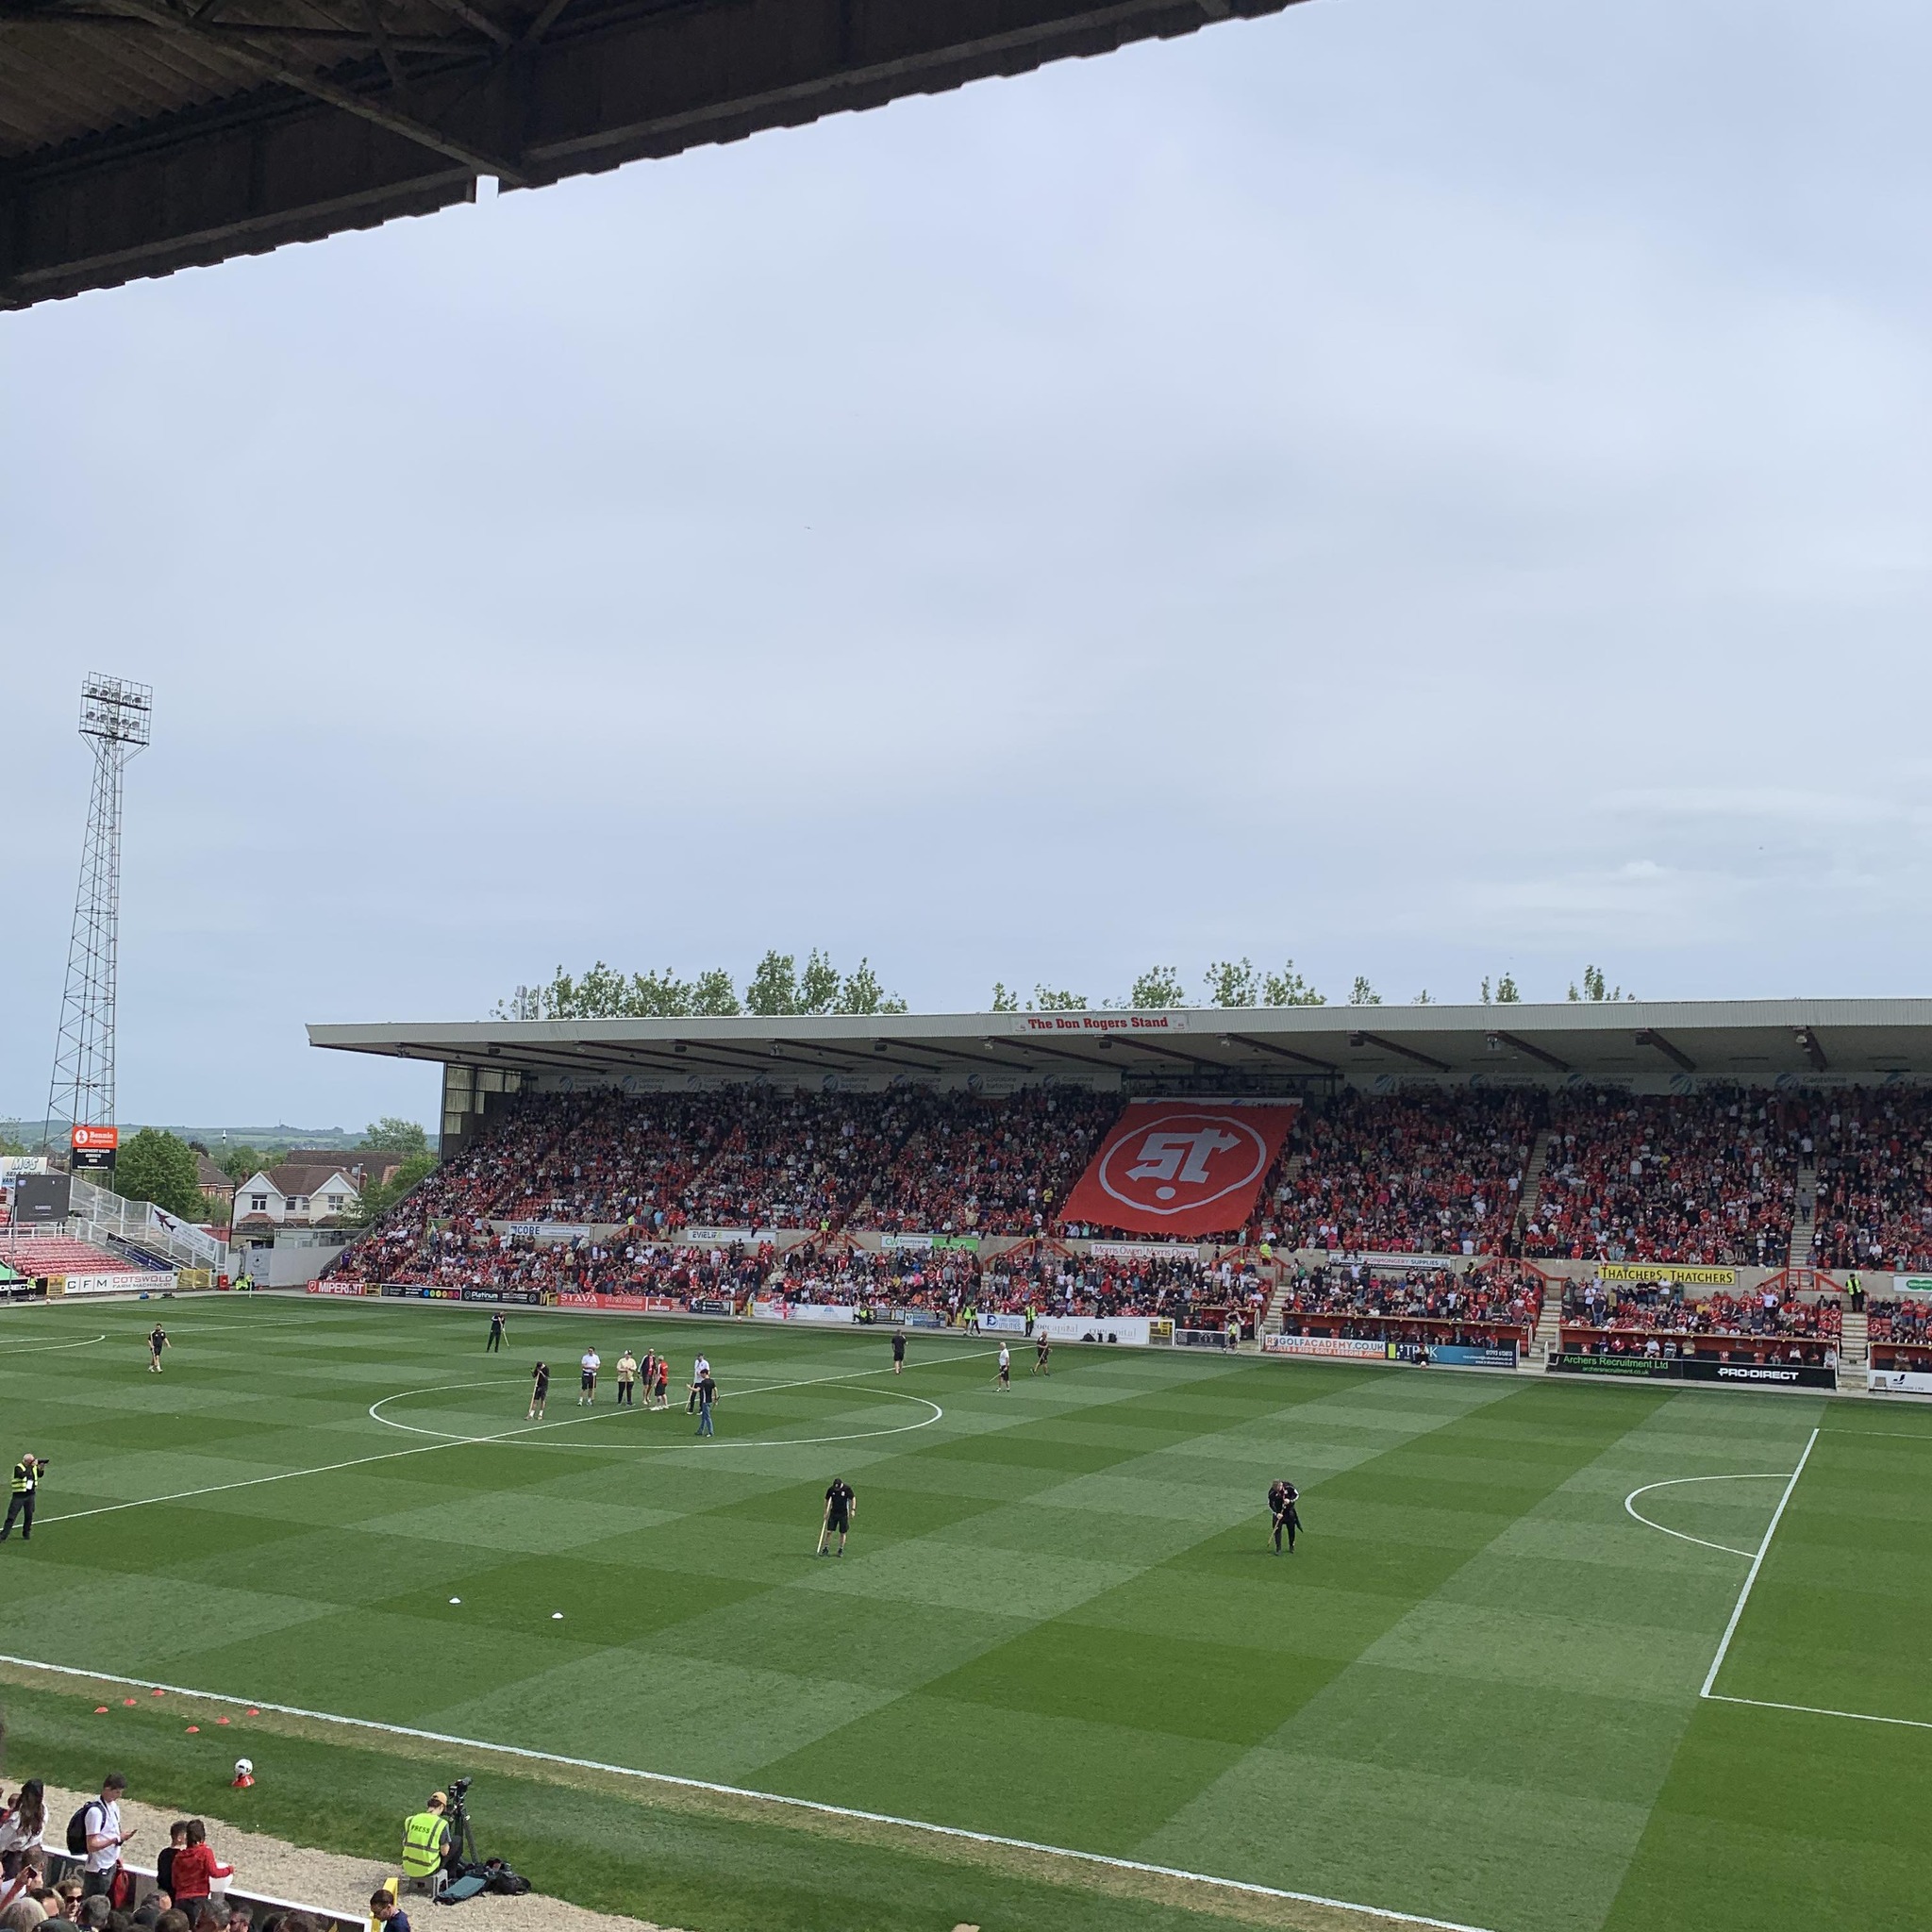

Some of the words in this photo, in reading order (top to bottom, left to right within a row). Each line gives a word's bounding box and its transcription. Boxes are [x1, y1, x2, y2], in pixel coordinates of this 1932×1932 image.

[1027, 1019, 1053, 1029] The
[1055, 1018, 1080, 1029] Don
[1084, 1017, 1127, 1031] Rogers
[1131, 1016, 1169, 1028] Stand
[11, 1157, 39, 1171] M&S
[1094, 1245, 1119, 1255] Morris
[1119, 1245, 1143, 1256] Owen
[1146, 1247, 1171, 1257] Morris
[1172, 1248, 1195, 1257] Owen
[112, 1275, 173, 1284] COTSWOLD
[1670, 1270, 1733, 1284] THATCHERS
[560, 1293, 598, 1303] STAVA
[1404, 1344, 1438, 1358] TRK
[1563, 1355, 1597, 1365] Archers
[1599, 1357, 1653, 1369] Recruitment
[1654, 1359, 1669, 1370] Ltd
[1717, 1367, 1800, 1380] PRO:DIRECT
[410, 1824, 431, 1834] PRESS
